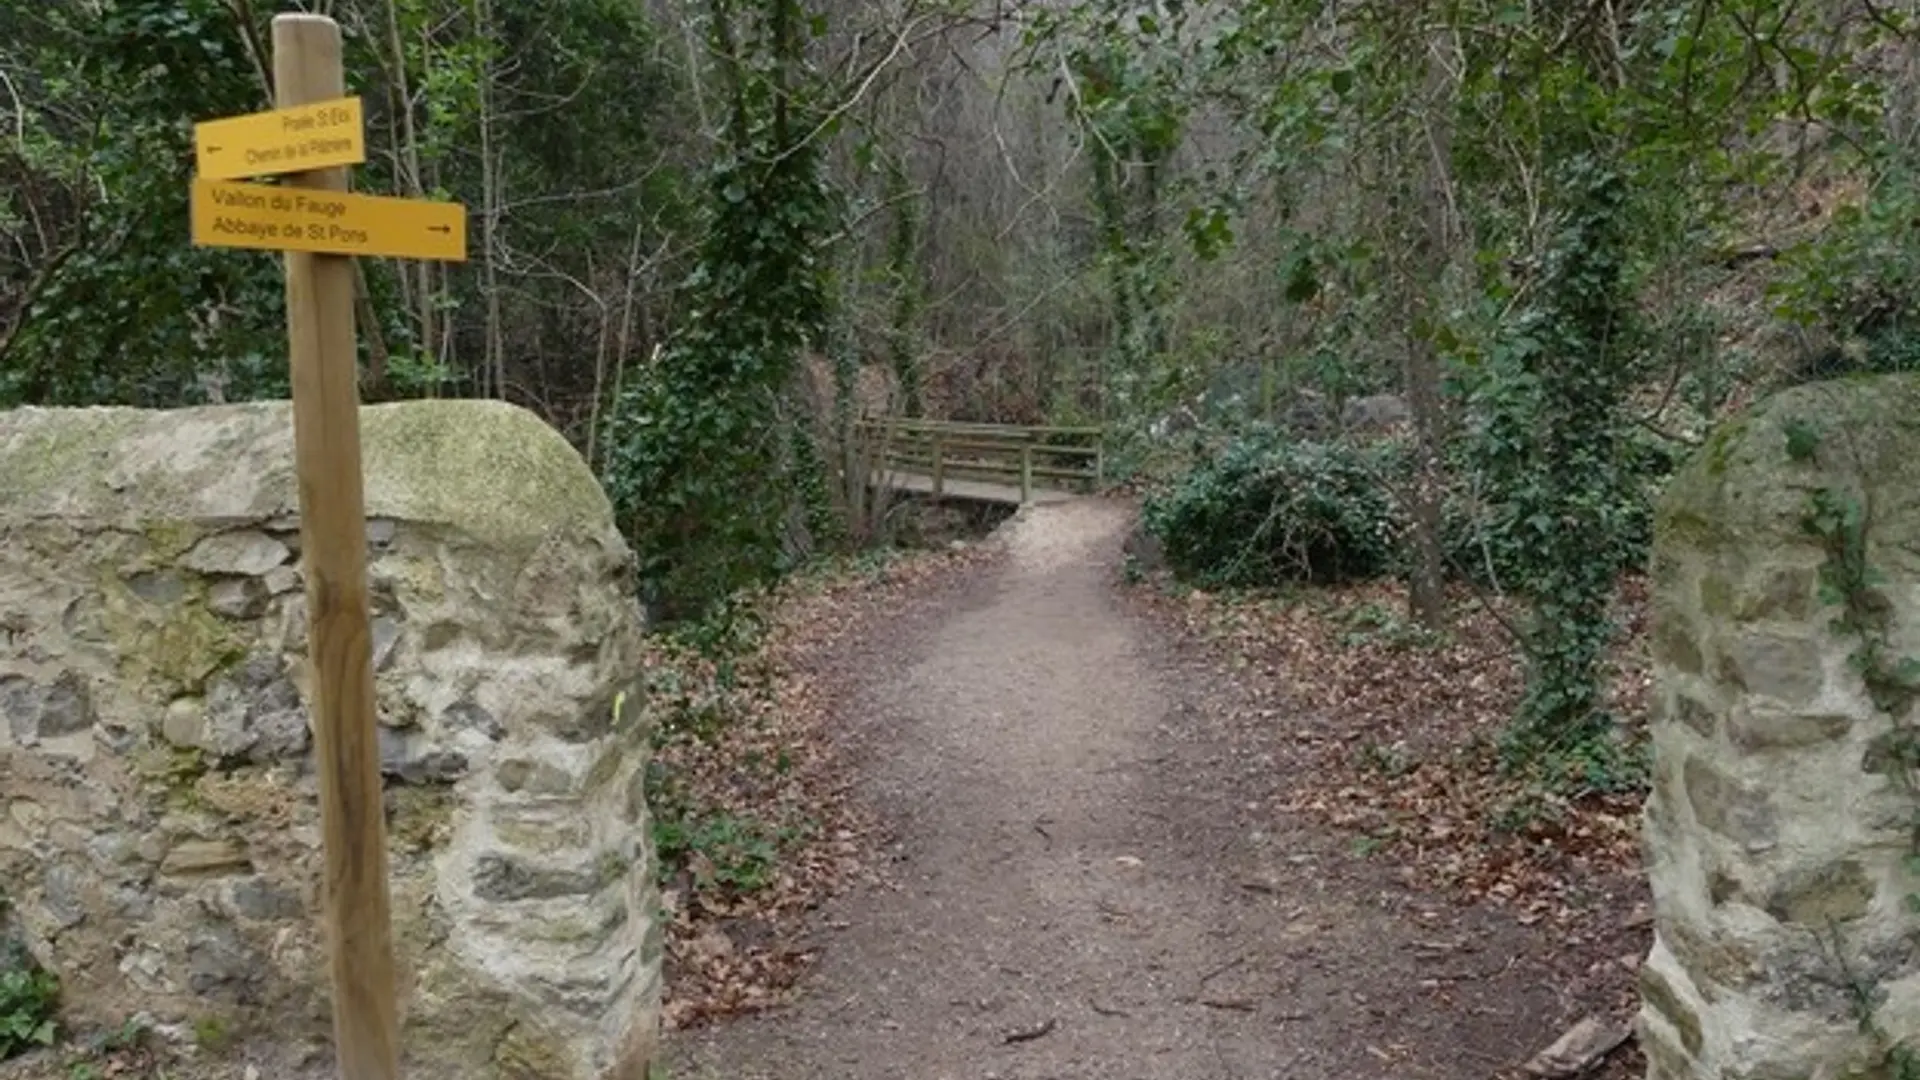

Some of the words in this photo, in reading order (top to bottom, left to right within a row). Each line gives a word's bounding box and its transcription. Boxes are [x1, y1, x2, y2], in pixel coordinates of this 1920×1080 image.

[211, 188, 266, 209] Vallon
[270, 196, 292, 212] du
[295, 196, 347, 218] Fauge
[212, 216, 278, 239] Abbaye
[282, 223, 303, 239] de
[329, 224, 369, 244] Pons
